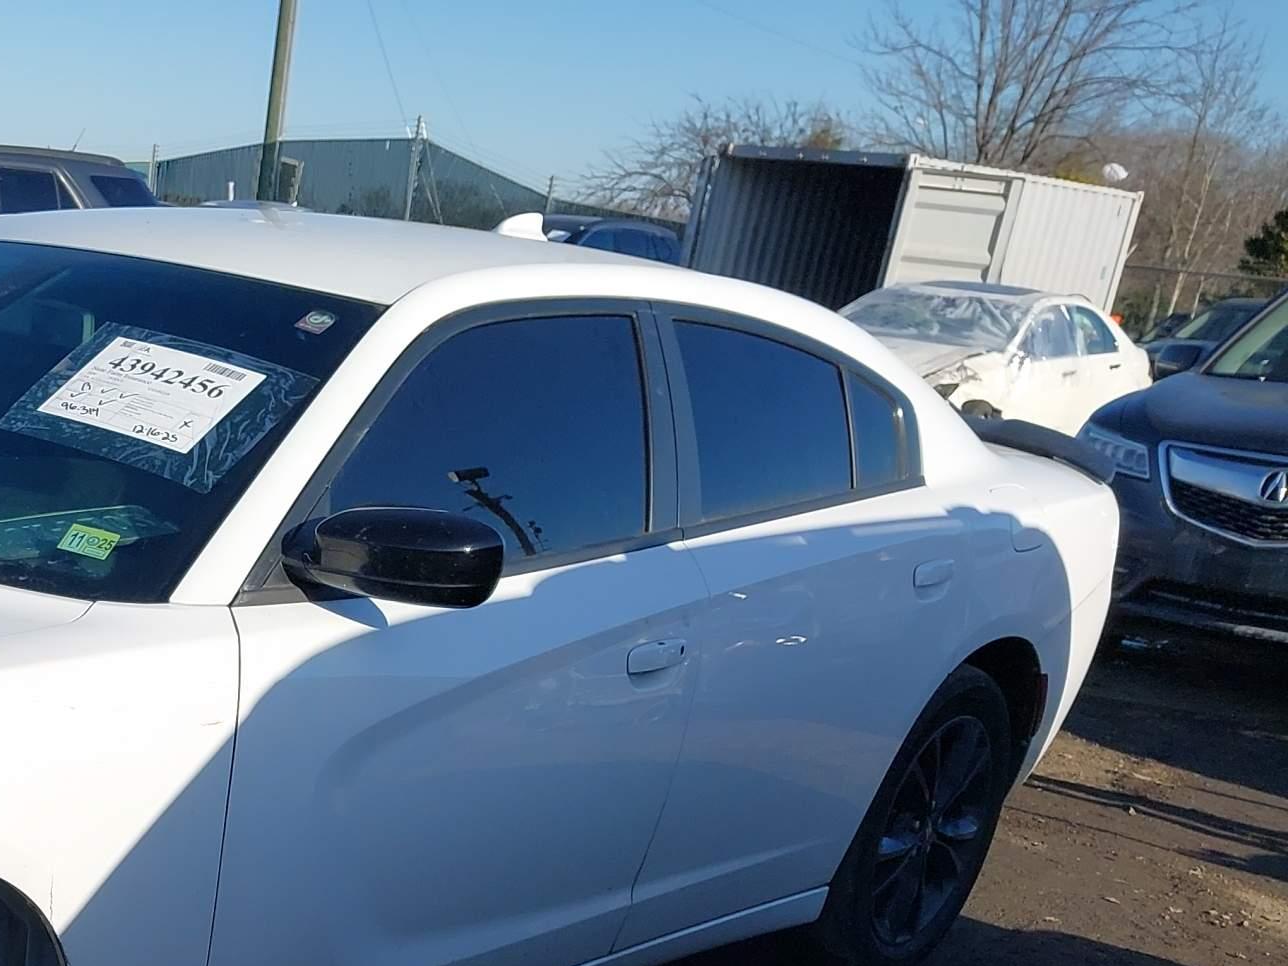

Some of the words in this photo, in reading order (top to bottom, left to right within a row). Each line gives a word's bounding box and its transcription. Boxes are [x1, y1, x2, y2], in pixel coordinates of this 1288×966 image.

[108, 354, 230, 398] 43942456
[68, 532, 87, 548] 11
[96, 537, 117, 551] 25
